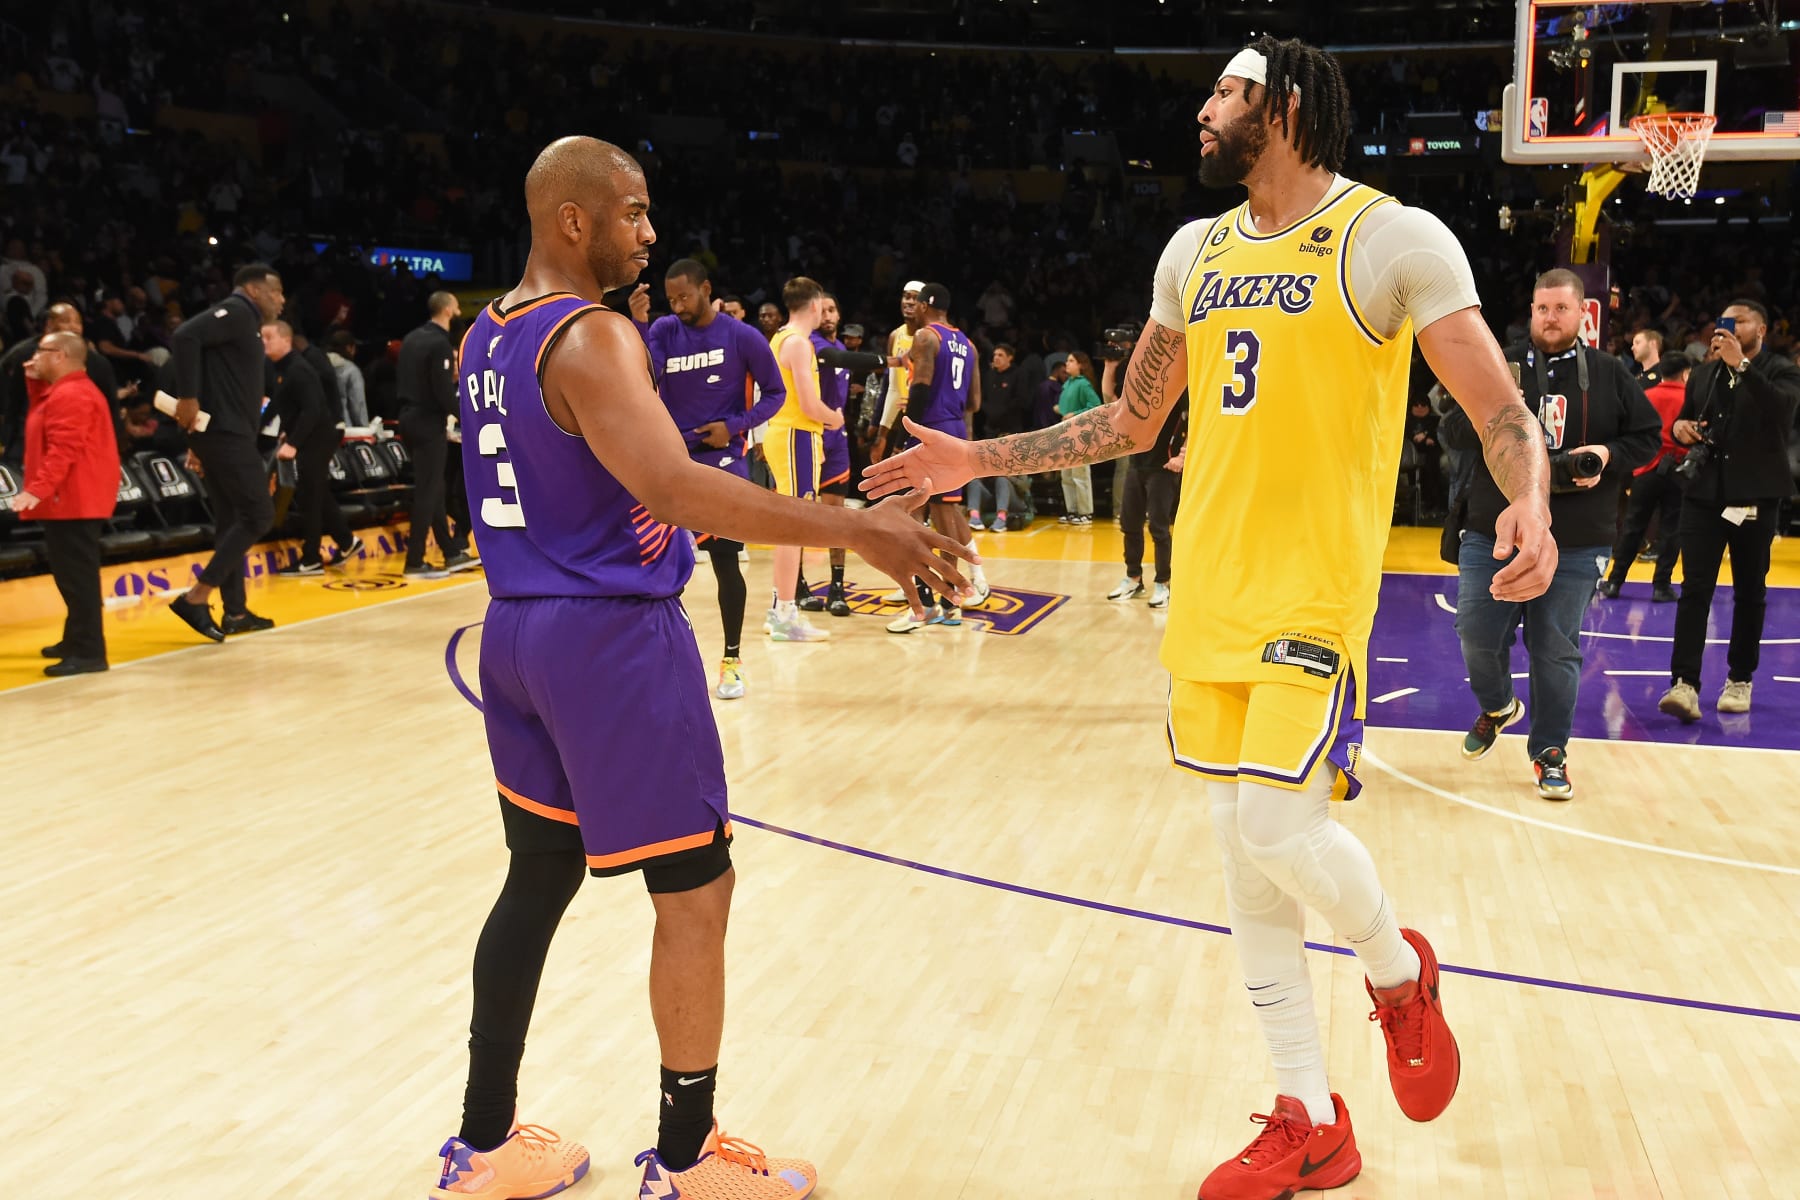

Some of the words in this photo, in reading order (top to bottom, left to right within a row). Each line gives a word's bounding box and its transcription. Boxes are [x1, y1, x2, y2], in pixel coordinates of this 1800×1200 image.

[1426, 141, 1461, 150] TOYOTA
[1214, 228, 1227, 245] 6
[1299, 243, 1333, 257] bibigo
[1188, 270, 1319, 326] LAKERS
[666, 348, 724, 374] SUNS
[952, 356, 965, 389] 0
[1221, 328, 1262, 416] 3
[467, 370, 507, 416] PAL
[478, 423, 527, 528] 3
[111, 572, 171, 598] OS
